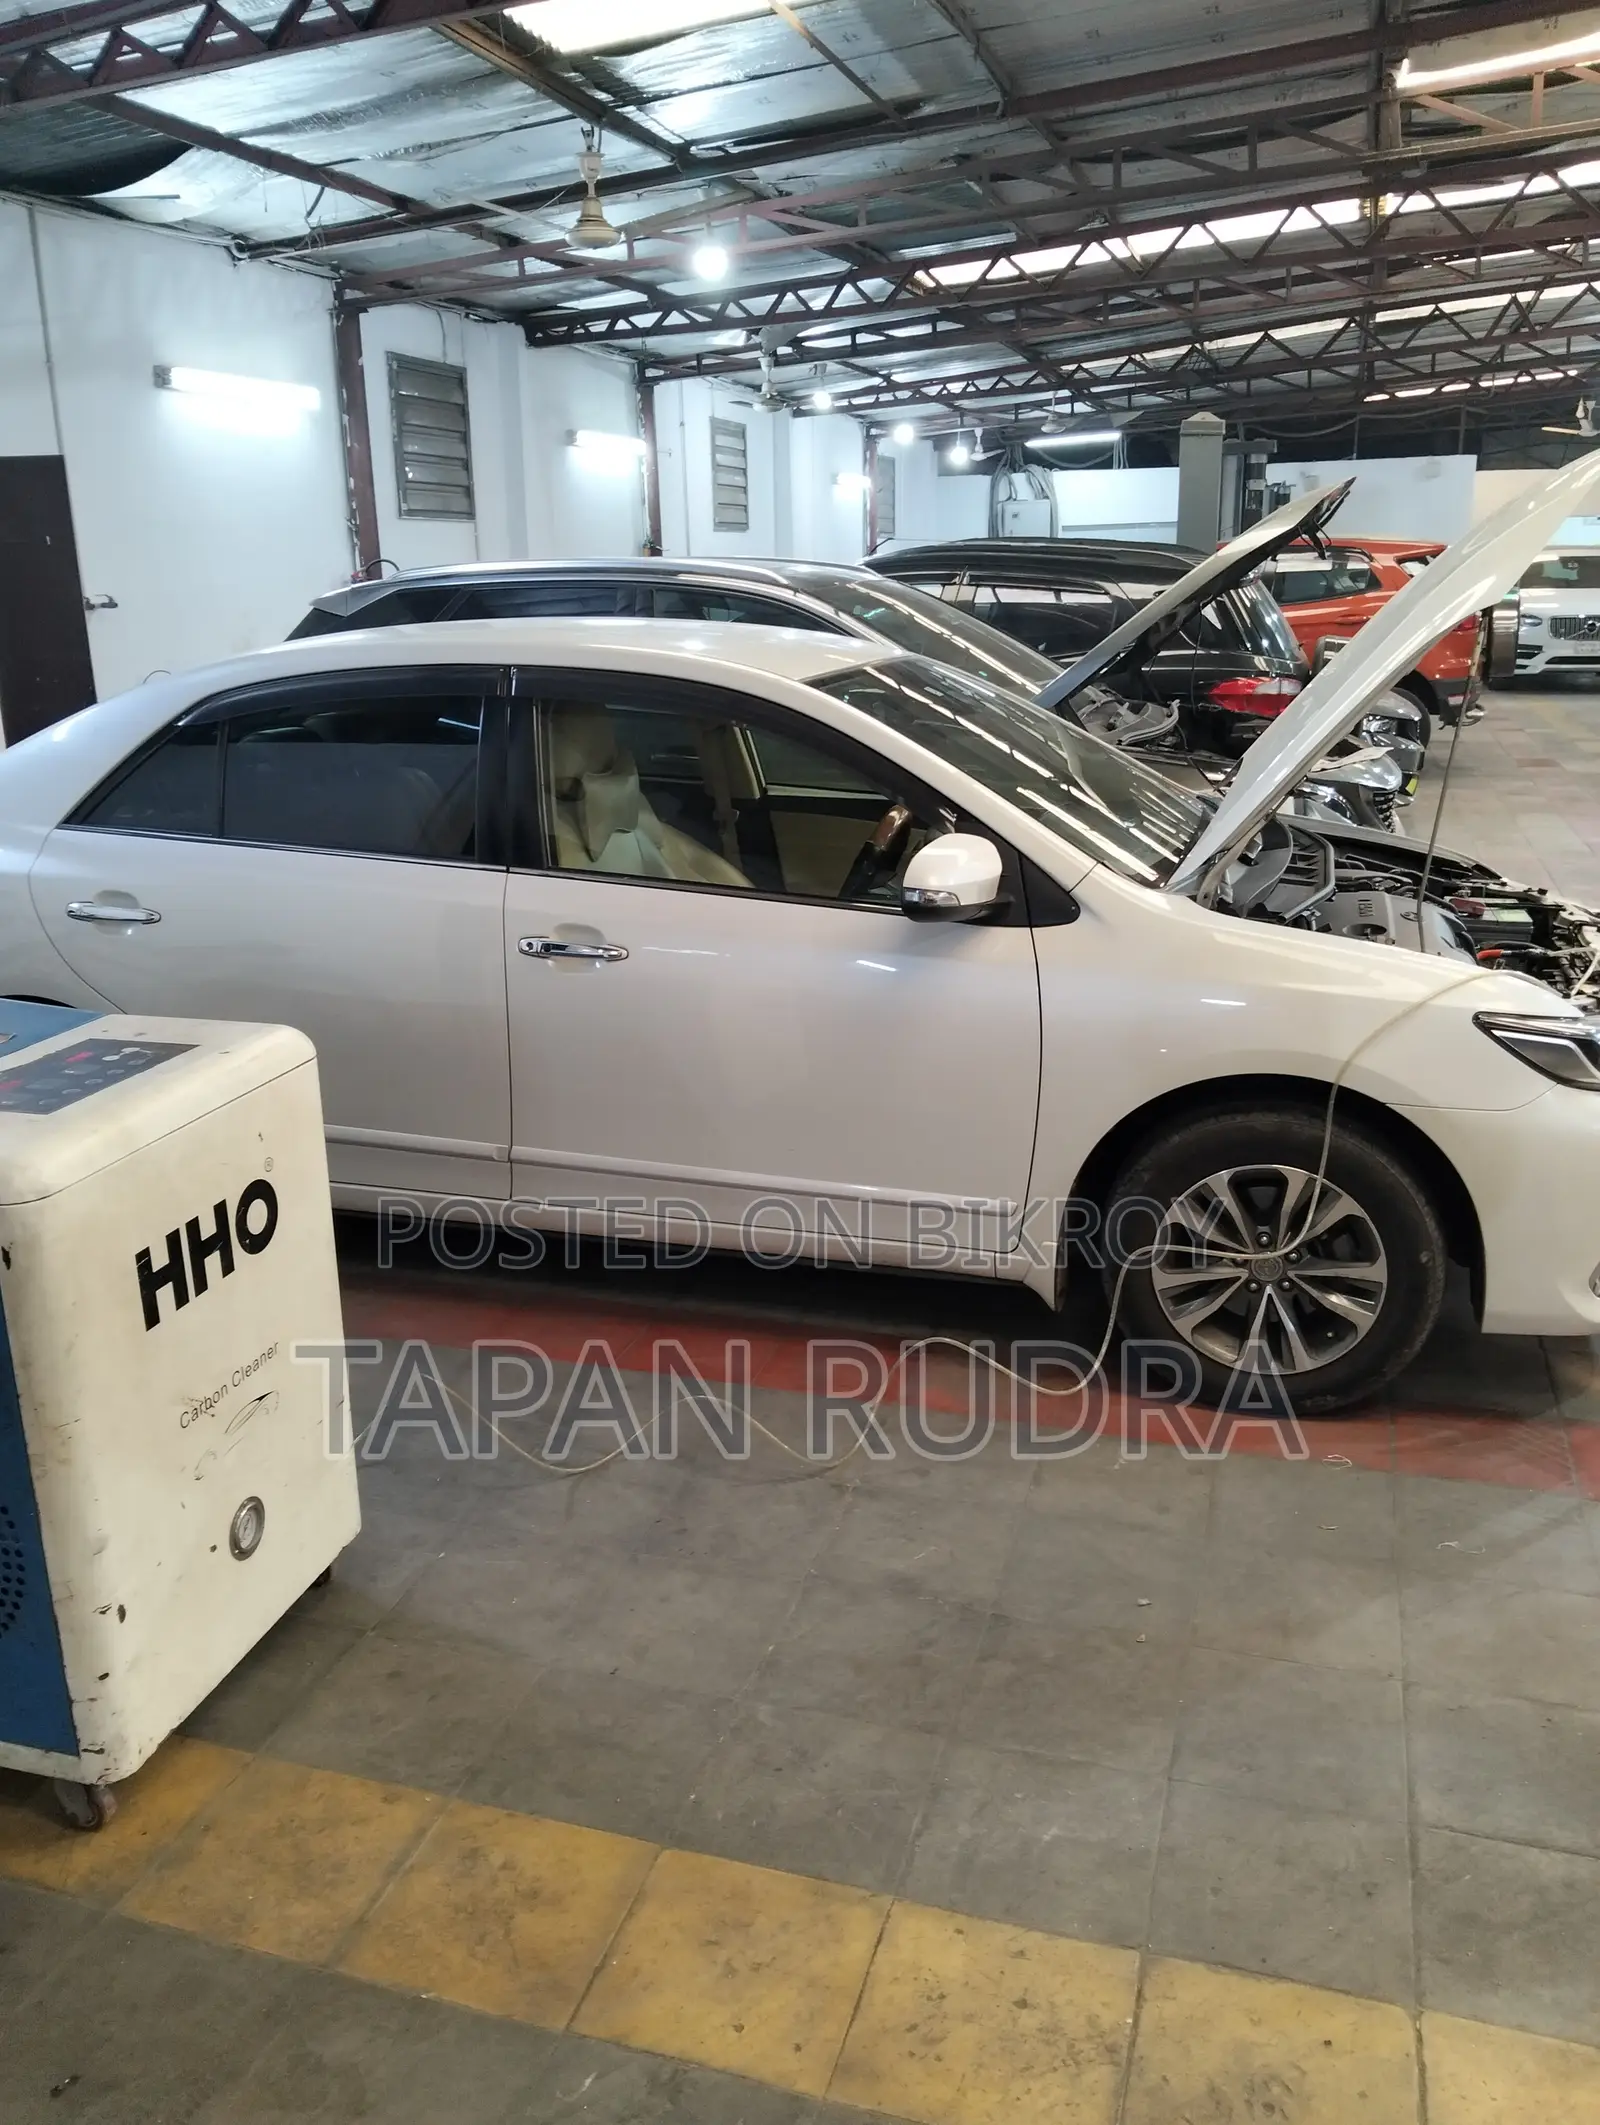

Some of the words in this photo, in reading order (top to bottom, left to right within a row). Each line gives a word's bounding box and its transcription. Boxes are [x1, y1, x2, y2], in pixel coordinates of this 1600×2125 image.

[135, 1178, 278, 1332] HHO
[180, 1384, 228, 1429] Carbon
[231, 1341, 279, 1387] Cleaner
